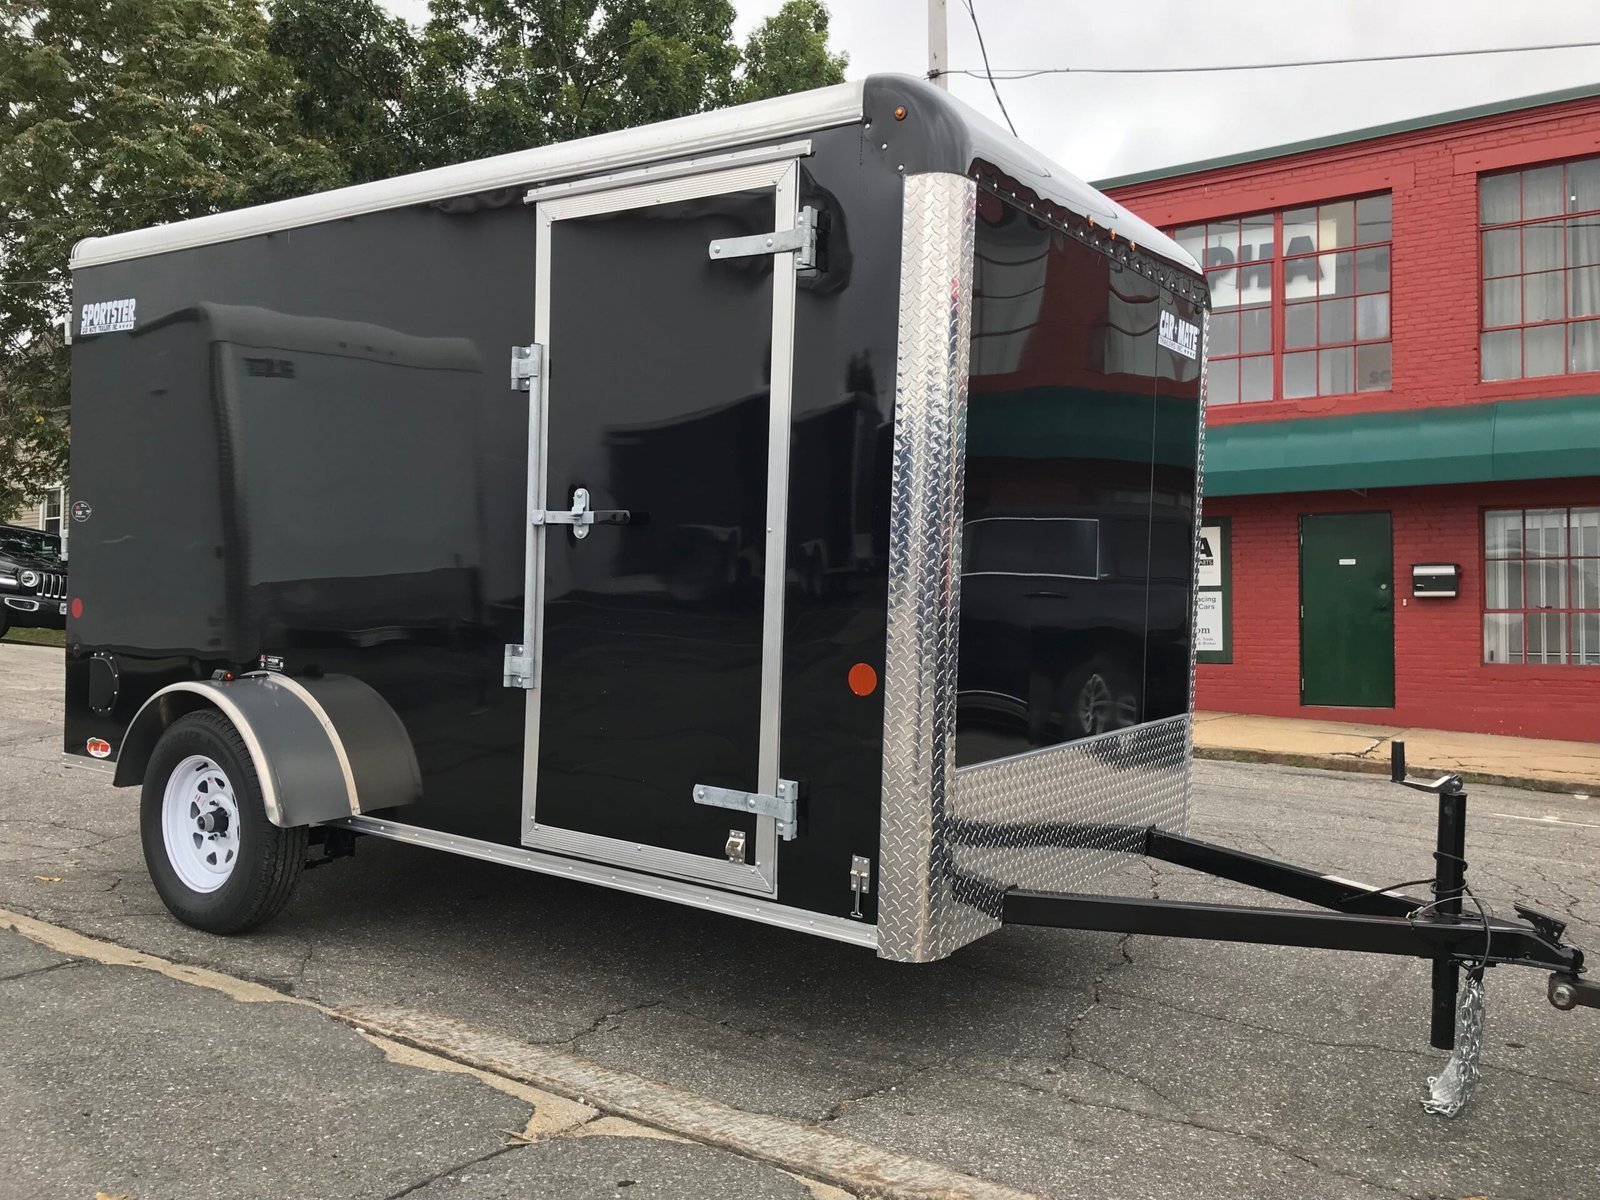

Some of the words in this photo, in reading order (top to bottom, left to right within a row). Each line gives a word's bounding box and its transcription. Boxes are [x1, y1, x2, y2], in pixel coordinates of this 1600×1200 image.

[81, 298, 136, 327] SPORTSTER
[1160, 310, 1175, 341] CAR
[1178, 319, 1198, 351] MATE
